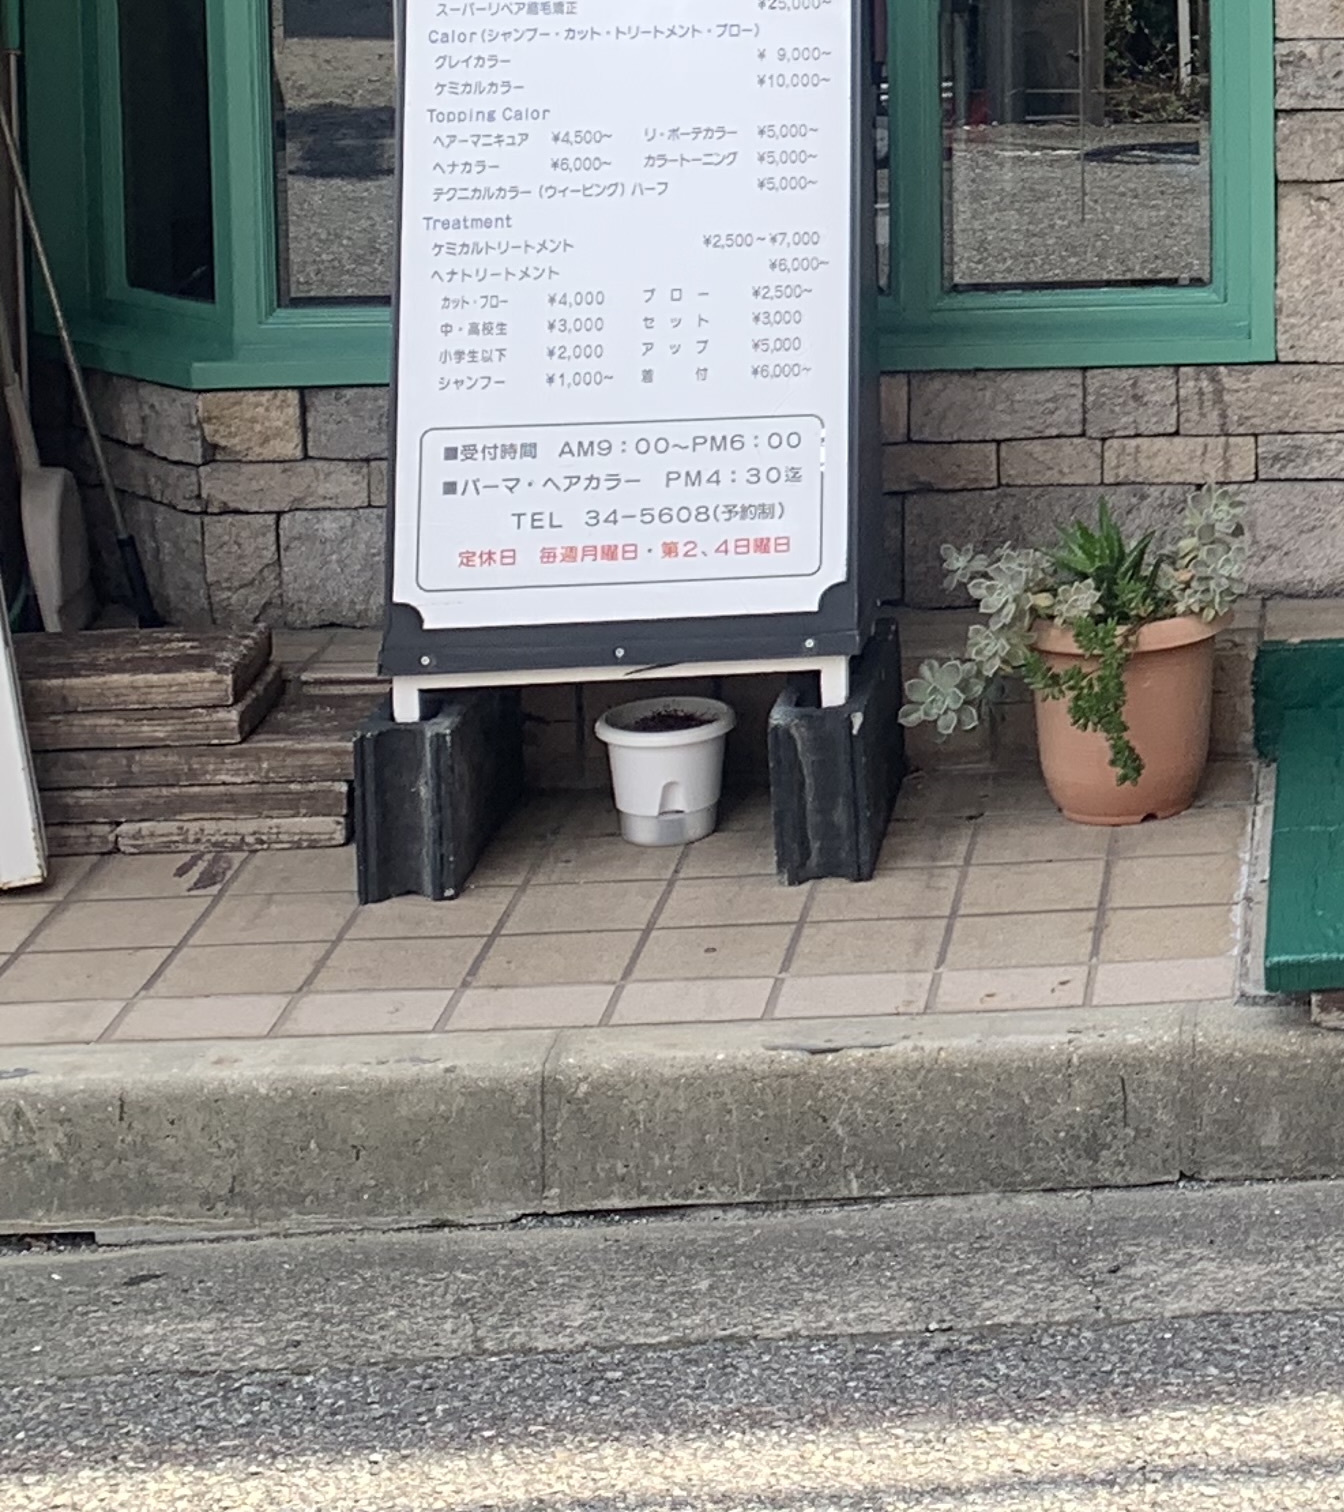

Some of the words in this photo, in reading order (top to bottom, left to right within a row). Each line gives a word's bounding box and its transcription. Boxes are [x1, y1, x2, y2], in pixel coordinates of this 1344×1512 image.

[434, 54, 511, 70] グレイカラー
[434, 80, 524, 96] ケミカルカラー
[426, 108, 497, 124] Topping
[502, 106, 551, 121] Calor
[433, 132, 529, 149] ヘアーマニキュア
[432, 159, 500, 175] ヘナカラー
[643, 150, 738, 168] カラートーニング
[422, 214, 513, 231] Treatment
[431, 238, 574, 256] ケミカルトリートメント
[431, 265, 560, 283] ヘナトリートメント
[547, 291, 605, 308] ¥4,000
[547, 317, 604, 334] ¥3,000
[751, 310, 802, 326] ¥3,000
[438, 348, 507, 365] 小学生以下
[546, 344, 604, 361] ¥2,000
[751, 336, 802, 354] ¥5,000
[459, 442, 538, 462] 受付時間
[511, 511, 563, 530] TEL
[458, 548, 517, 568] 定休日
